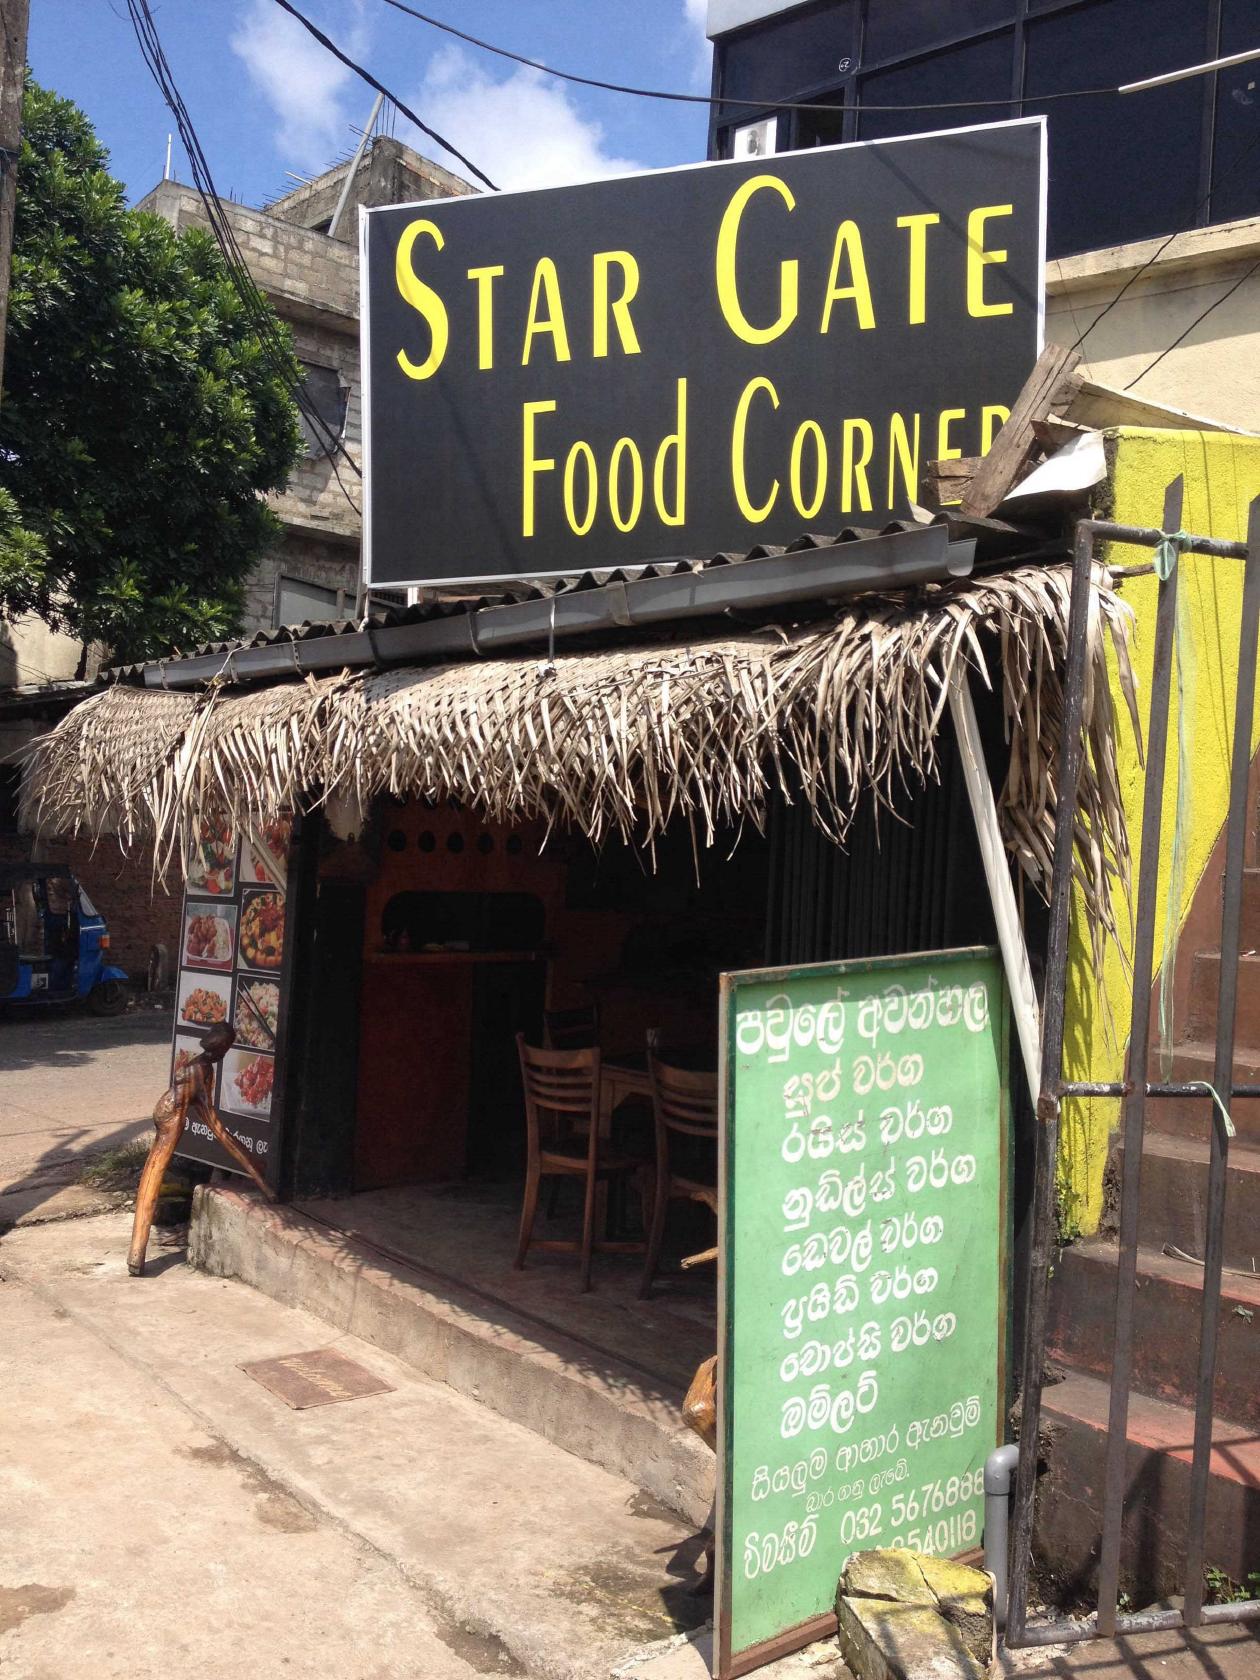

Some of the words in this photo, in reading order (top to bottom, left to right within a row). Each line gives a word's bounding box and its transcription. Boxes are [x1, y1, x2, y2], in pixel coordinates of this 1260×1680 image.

[396, 219, 641, 380] STAR
[715, 174, 1015, 345] GATE
[736, 986, 850, 1063] පවුලේ
[853, 1051, 924, 1095] වර්ග
[781, 1109, 866, 1163] රයිස්
[880, 1099, 952, 1144] වර්ග
[906, 1147, 976, 1192] වර්ග
[881, 1211, 944, 1253] වර්ග
[870, 1265, 938, 1304] වර්ග
[891, 1309, 956, 1352] වර්ග
[751, 1447, 827, 1502] සියලුම
[836, 1423, 899, 1472] ආහාර
[840, 1503, 882, 1544] 032
[891, 1467, 984, 1527] 5676888
